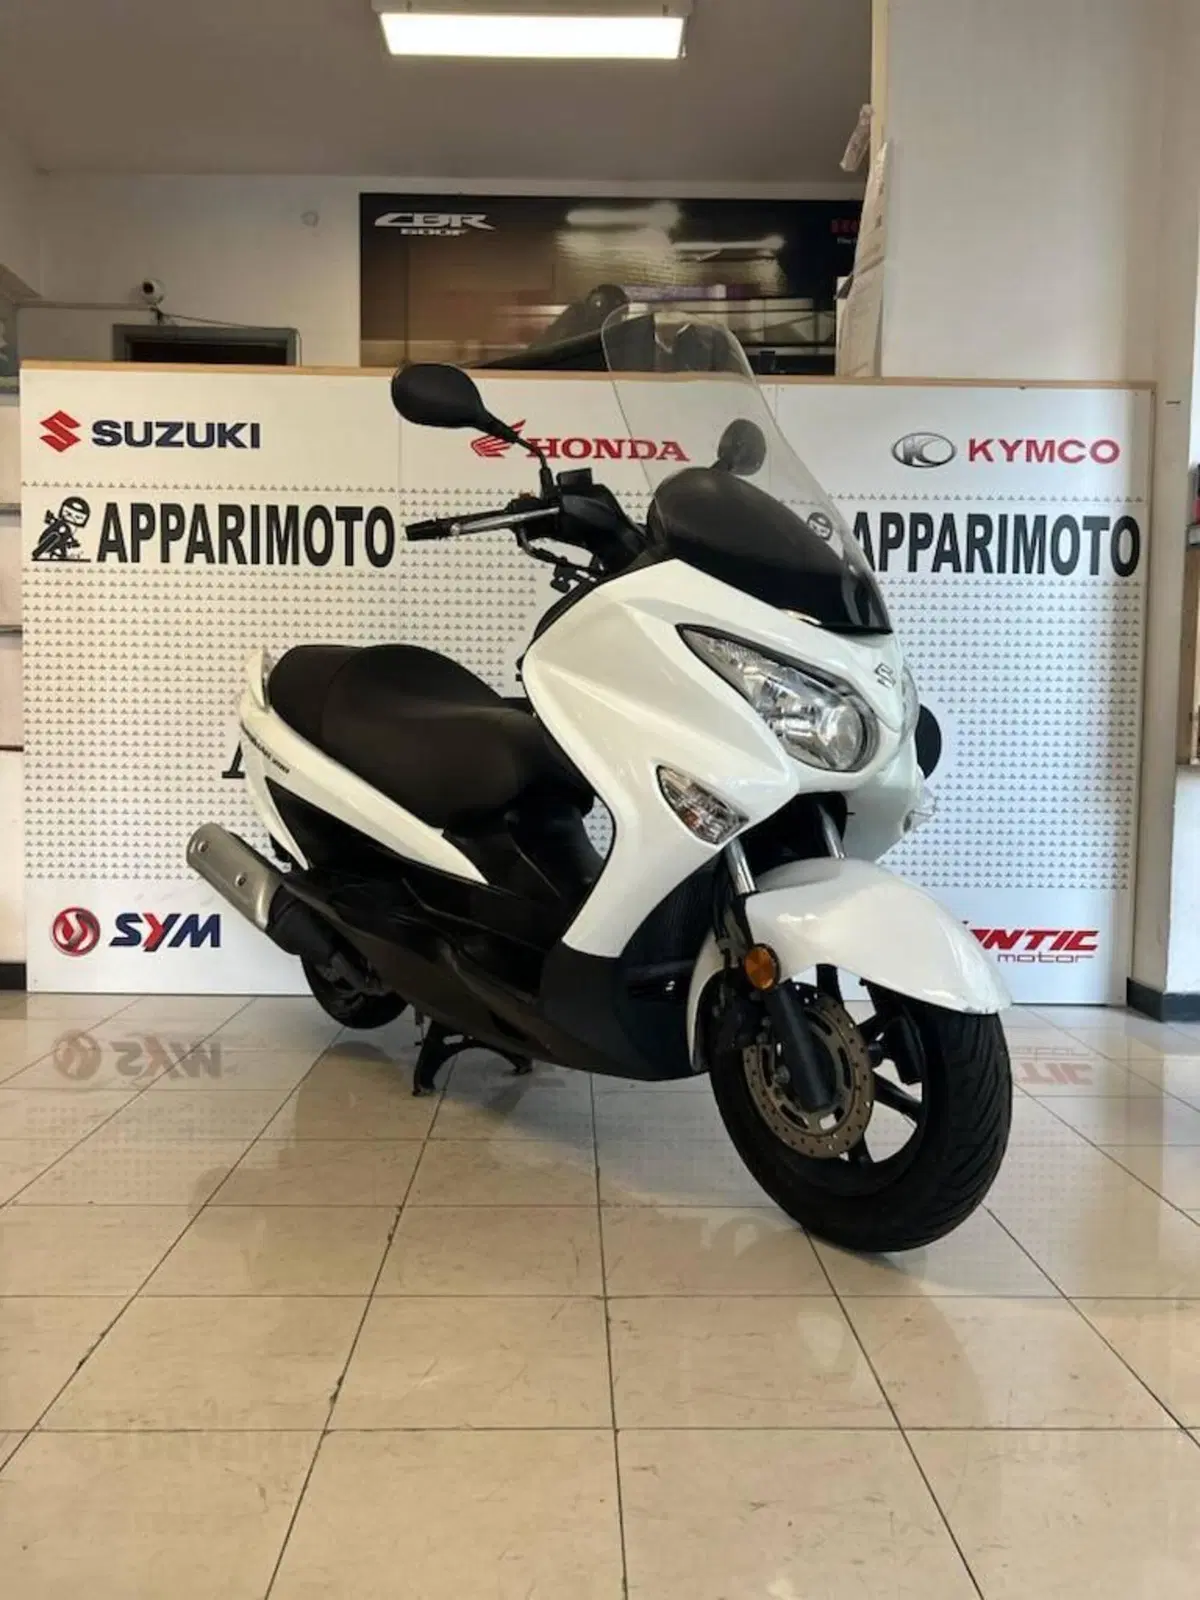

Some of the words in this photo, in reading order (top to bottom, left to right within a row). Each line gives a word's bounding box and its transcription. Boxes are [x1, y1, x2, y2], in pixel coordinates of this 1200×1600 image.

[374, 211, 496, 231] CBR
[91, 420, 261, 449] SUZUKI
[525, 437, 690, 462] HONDA
[967, 438, 1121, 464] KYMCO
[96, 501, 395, 568] APPARIMOTO
[852, 510, 1141, 578] APPARIMOTO
[108, 912, 222, 953] SYM
[969, 928, 1100, 951] NTIC
[997, 951, 1095, 964] motor
